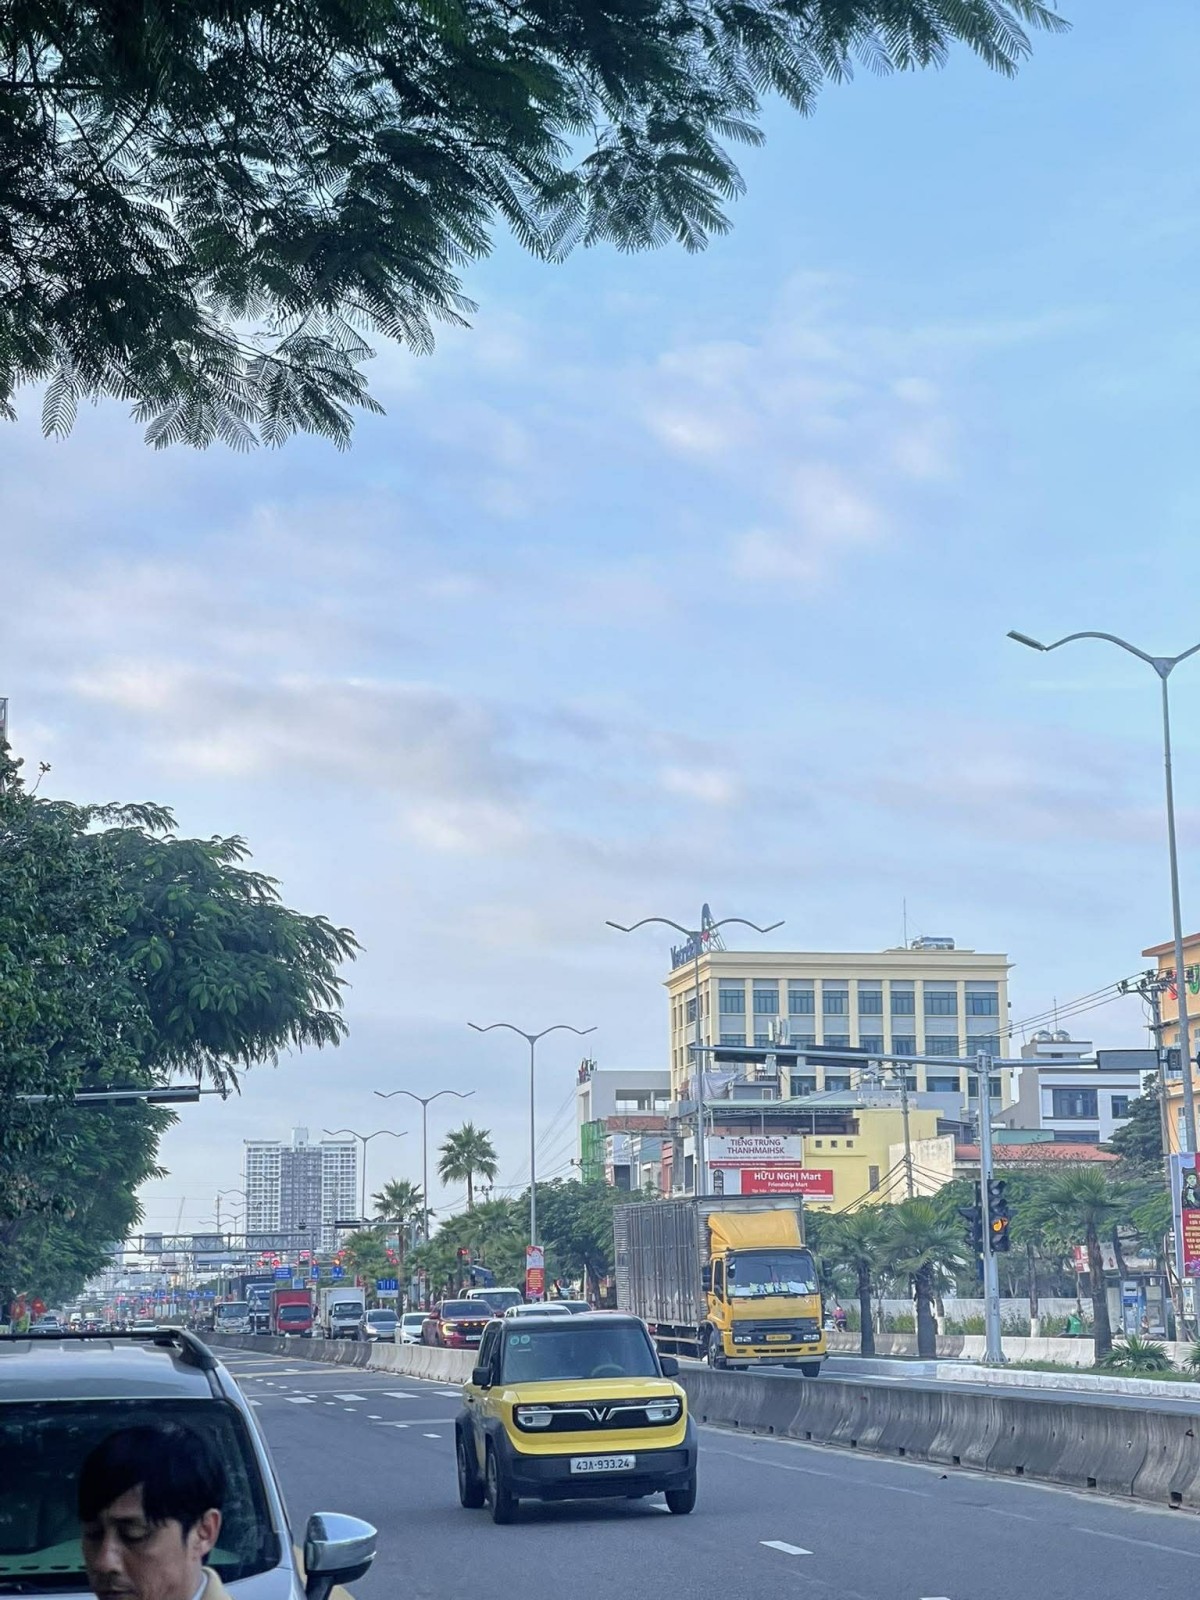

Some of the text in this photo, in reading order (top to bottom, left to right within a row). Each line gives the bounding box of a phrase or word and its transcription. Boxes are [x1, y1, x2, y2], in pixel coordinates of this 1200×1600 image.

[754, 1138, 781, 1146] TRUNG
[754, 1171, 822, 1182] HỮU NGHỊ Mart
